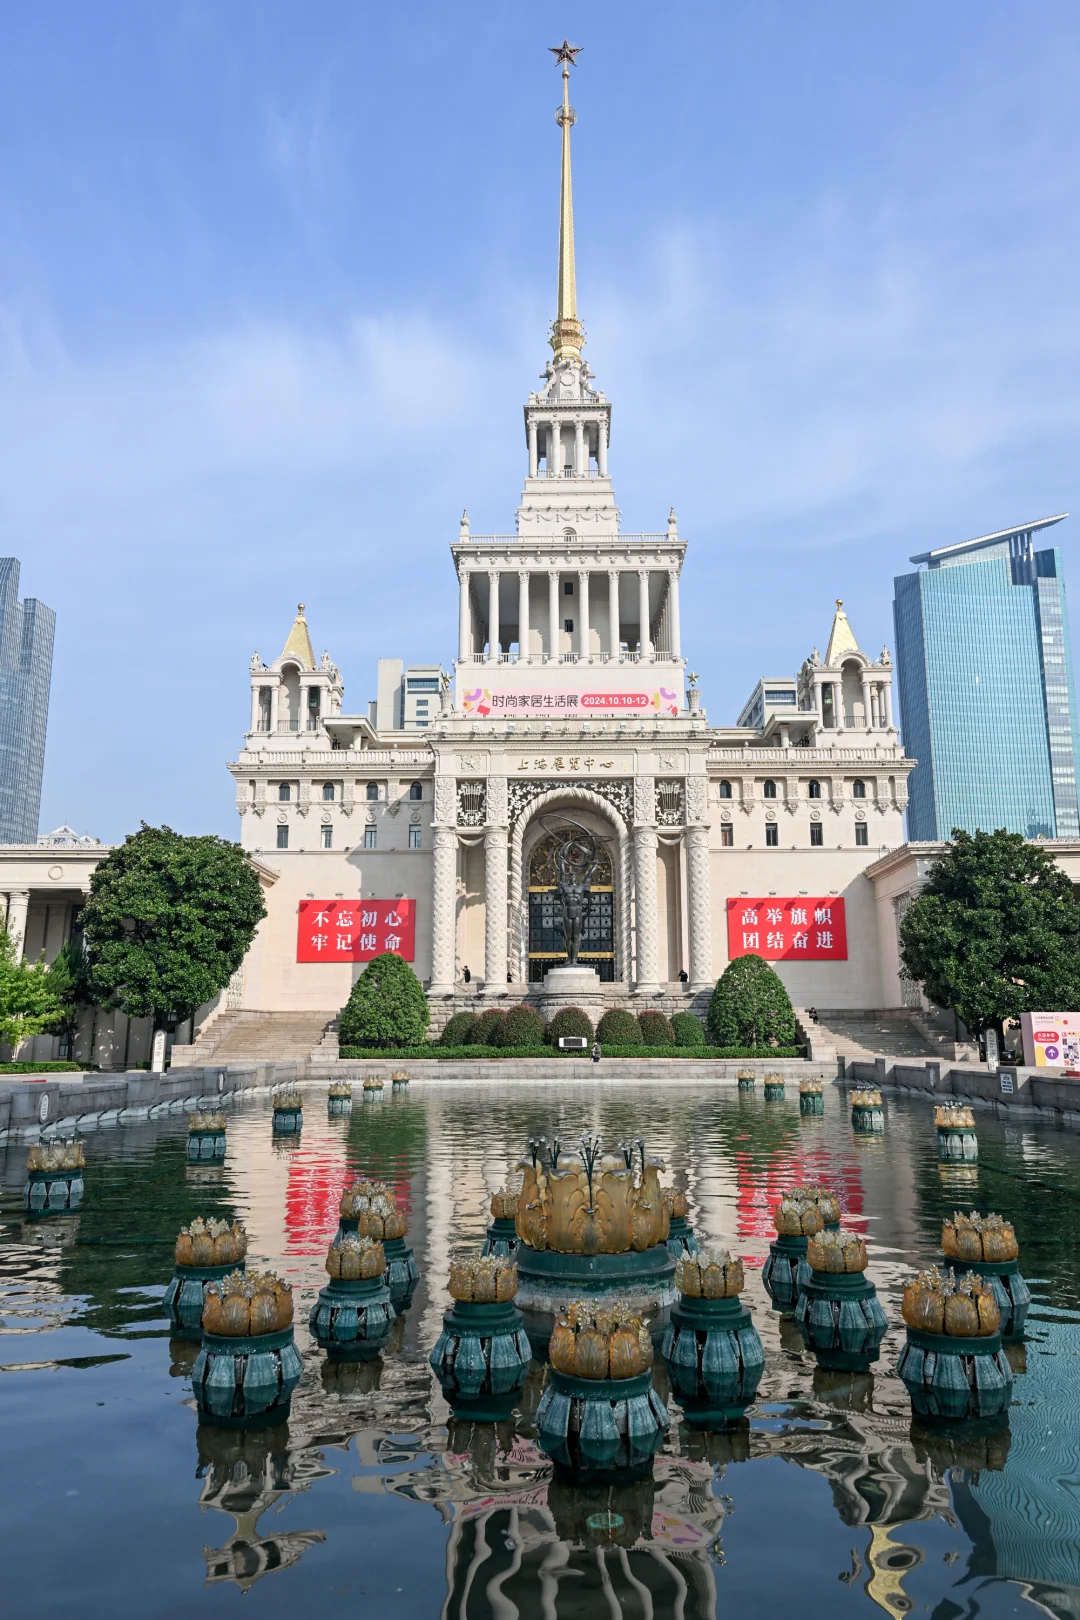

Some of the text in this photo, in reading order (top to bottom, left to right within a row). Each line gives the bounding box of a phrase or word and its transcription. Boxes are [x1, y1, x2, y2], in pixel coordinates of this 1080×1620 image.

[492, 695, 647, 707] 时尚家居生活展 2024.10.10-12
[517, 757, 614, 772] 上海展览中心
[312, 910, 402, 927] 不忘初心
[741, 907, 832, 925] 高举旗帜
[311, 933, 402, 951] 牢记使命
[743, 931, 834, 949] 团结奋进
